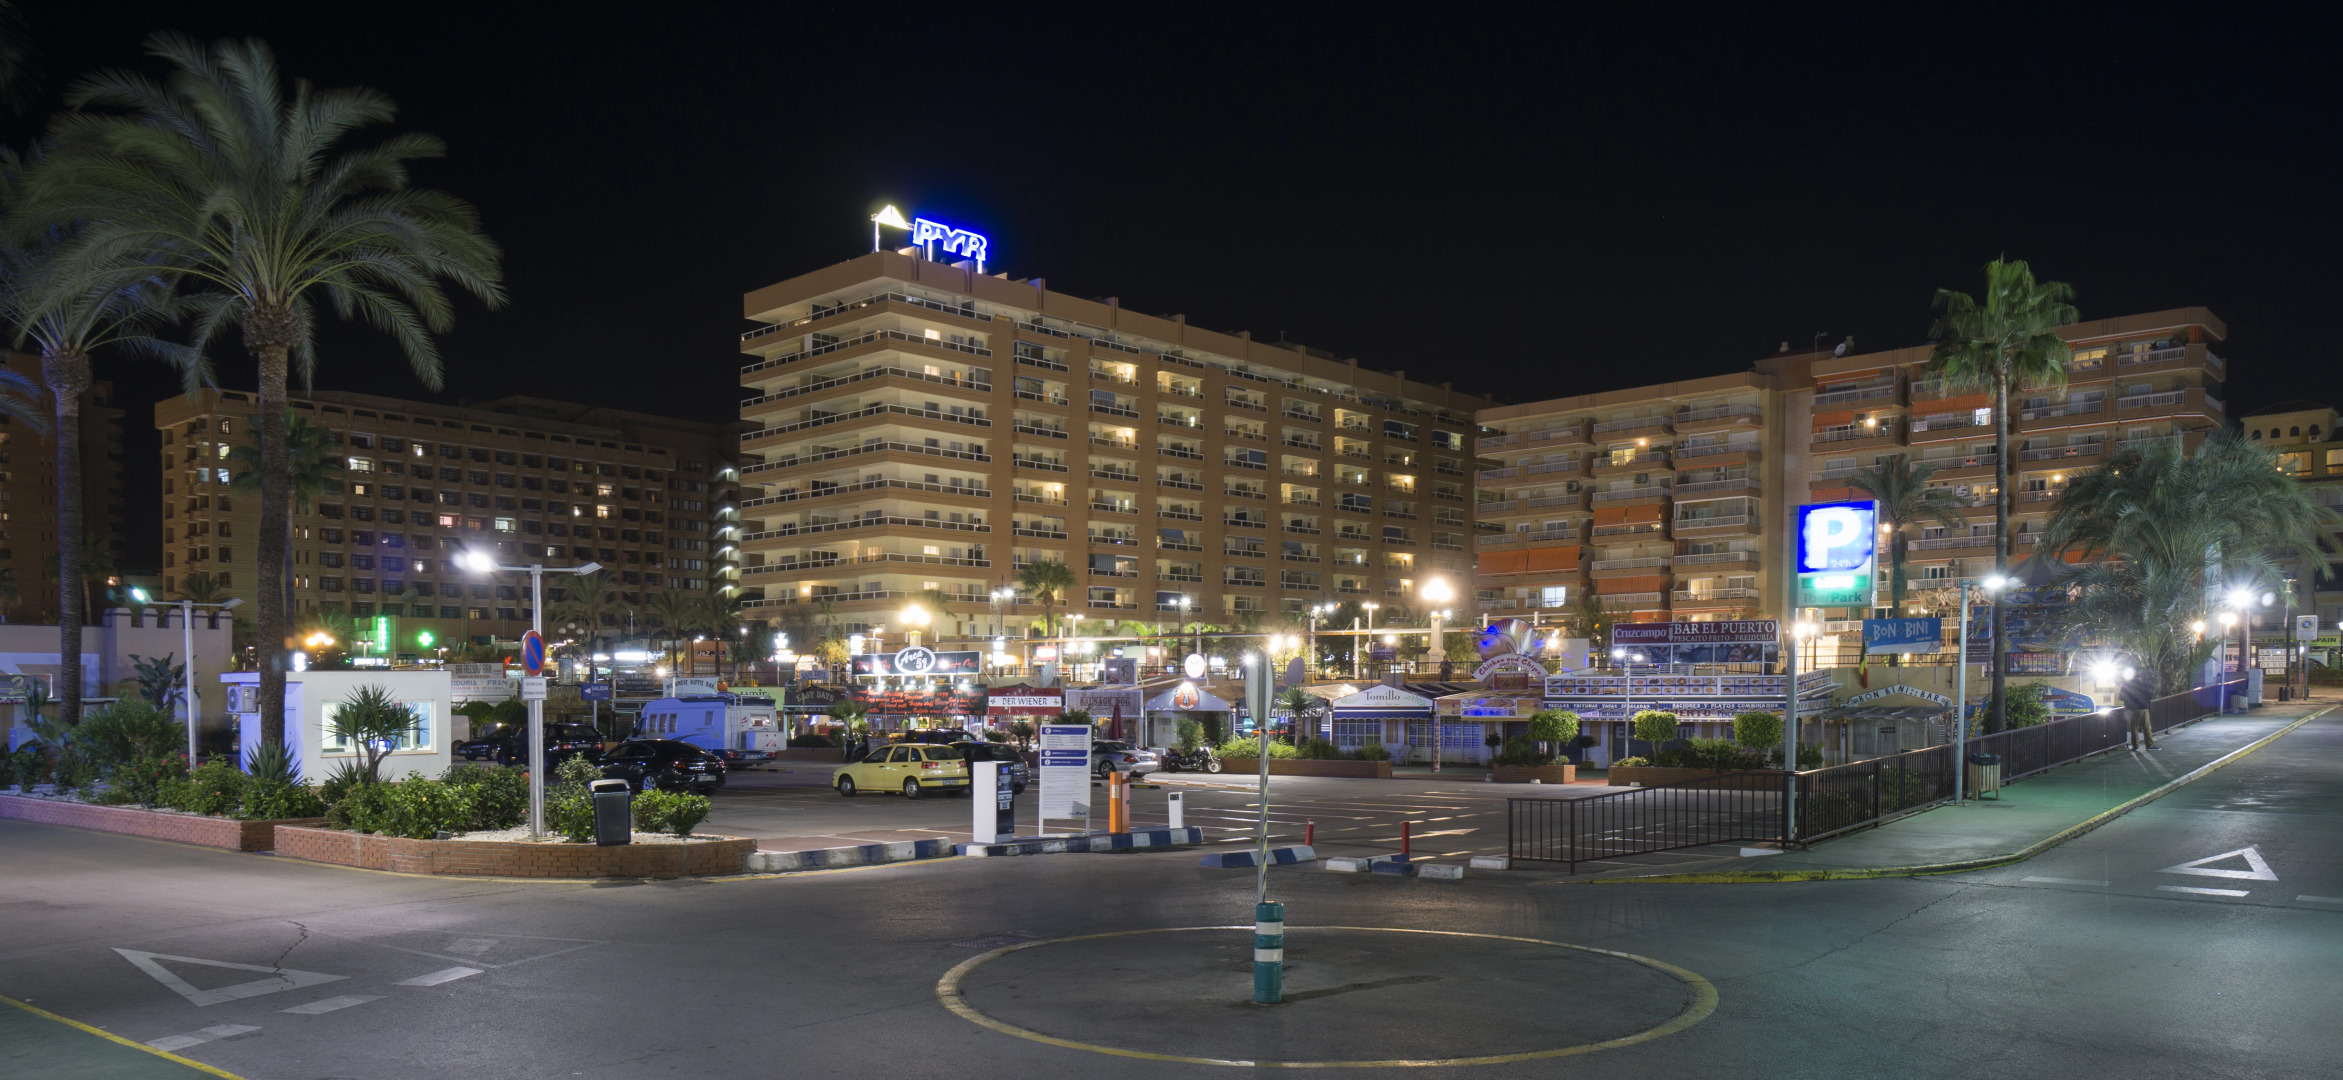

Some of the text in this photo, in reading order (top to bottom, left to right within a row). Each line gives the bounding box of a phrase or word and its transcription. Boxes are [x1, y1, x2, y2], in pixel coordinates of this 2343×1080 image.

[913, 217, 987, 262] PYR
[1809, 506, 1862, 569] P
[1615, 628, 1667, 640] Cruzcampo
[1674, 621, 1775, 634] BAR EL PUERTO
[1873, 621, 1929, 641] BON BINI
[900, 650, 924, 666] Area
[1478, 657, 1505, 676] Chicken
[1521, 658, 1542, 675] Chips
[451, 679, 477, 687] EIDURIA
[796, 690, 835, 702] EASY DAYS
[1364, 689, 1401, 702] Tomillo
[1859, 684, 1940, 702] BON BINI BAR
[1002, 697, 1048, 706] DER WIENER
